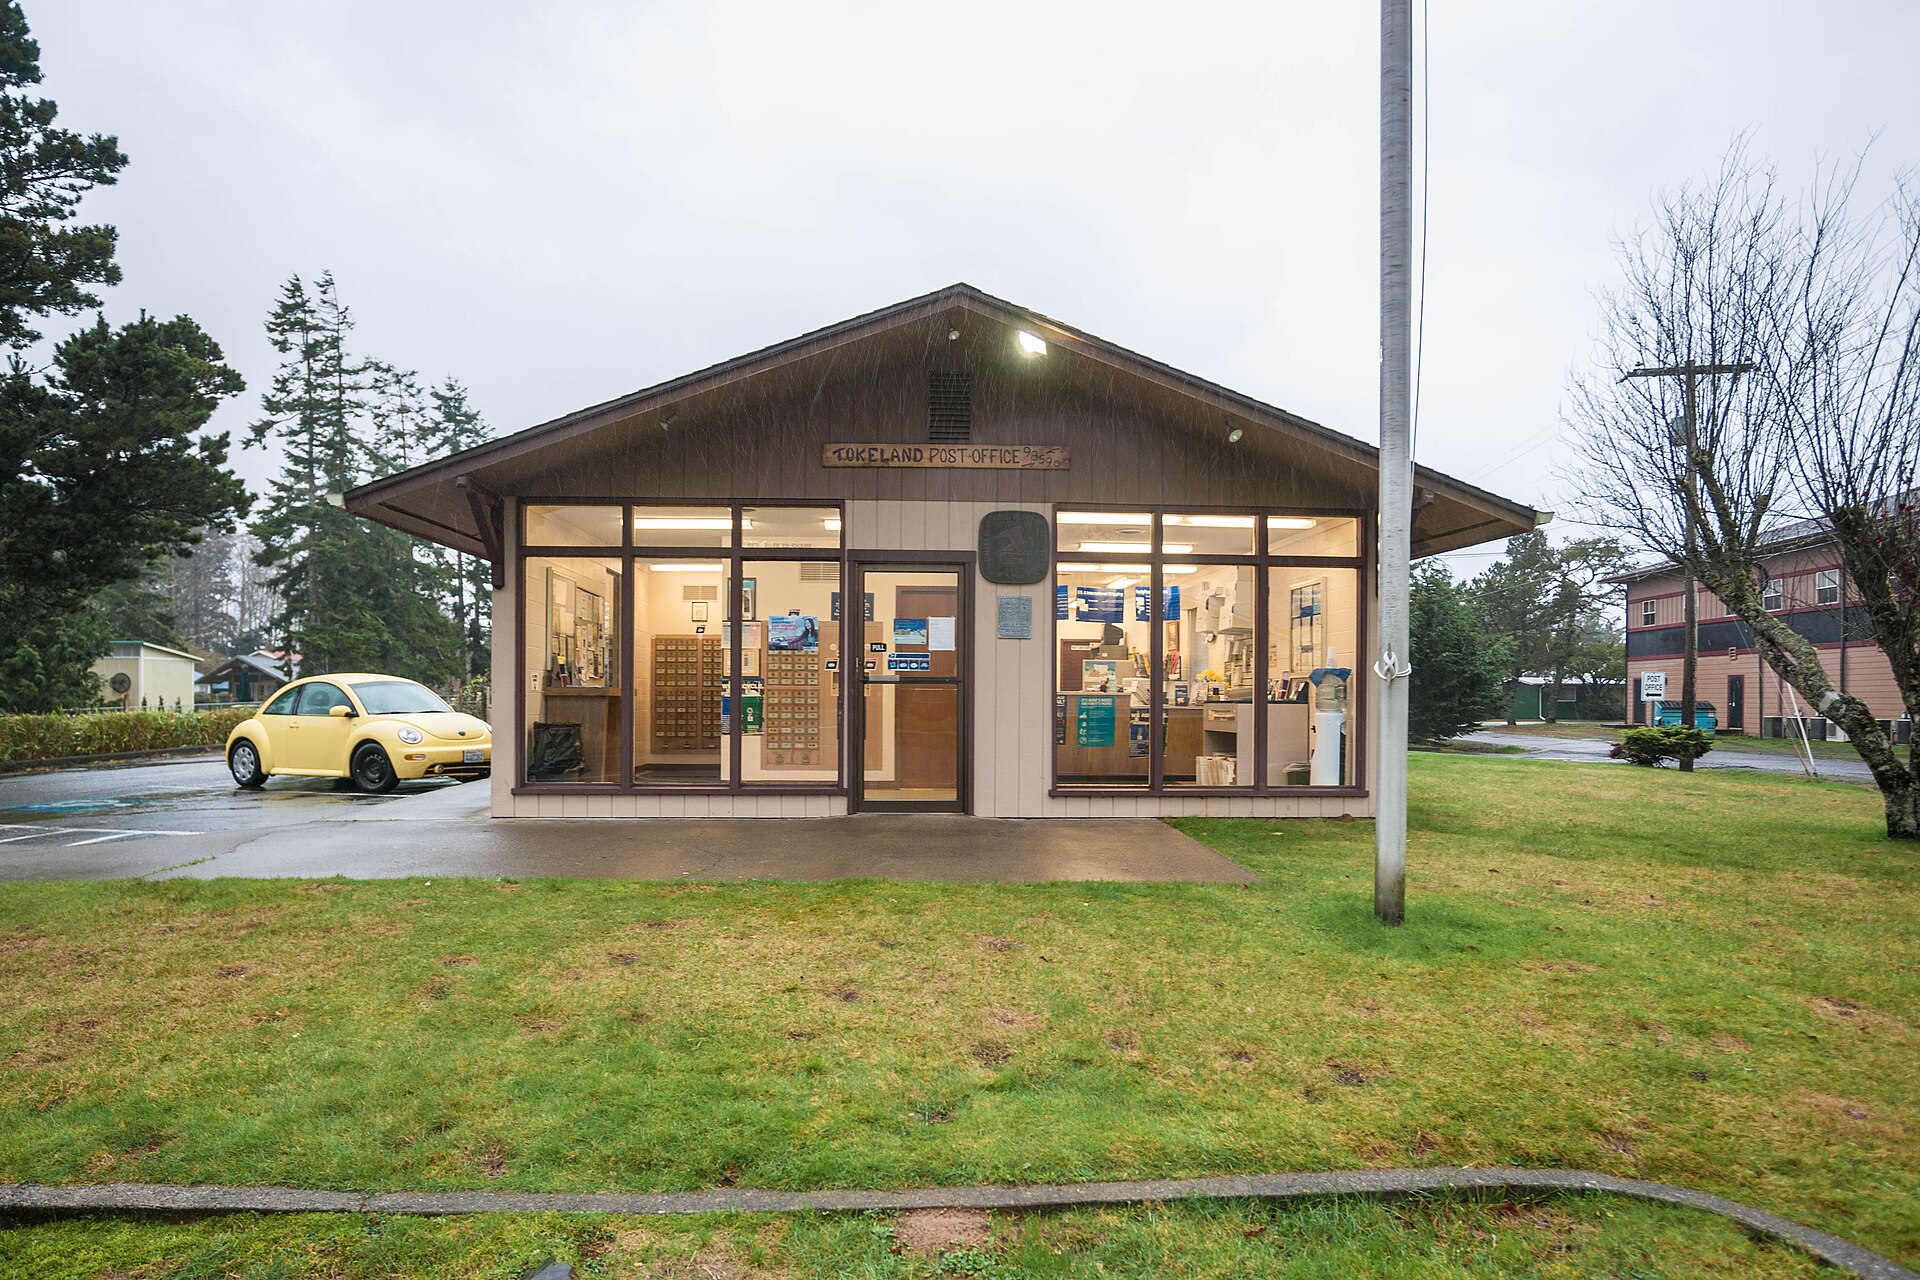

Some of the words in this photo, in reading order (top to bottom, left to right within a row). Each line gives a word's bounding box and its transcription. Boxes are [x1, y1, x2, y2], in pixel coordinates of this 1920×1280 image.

[832, 447, 923, 463] TOKELAND
[930, 448, 968, 463] POST
[972, 448, 1020, 464] OFFICE
[1023, 446, 1061, 467] 98590
[1647, 675, 1661, 683] POST
[1645, 683, 1663, 691] OFFICE
